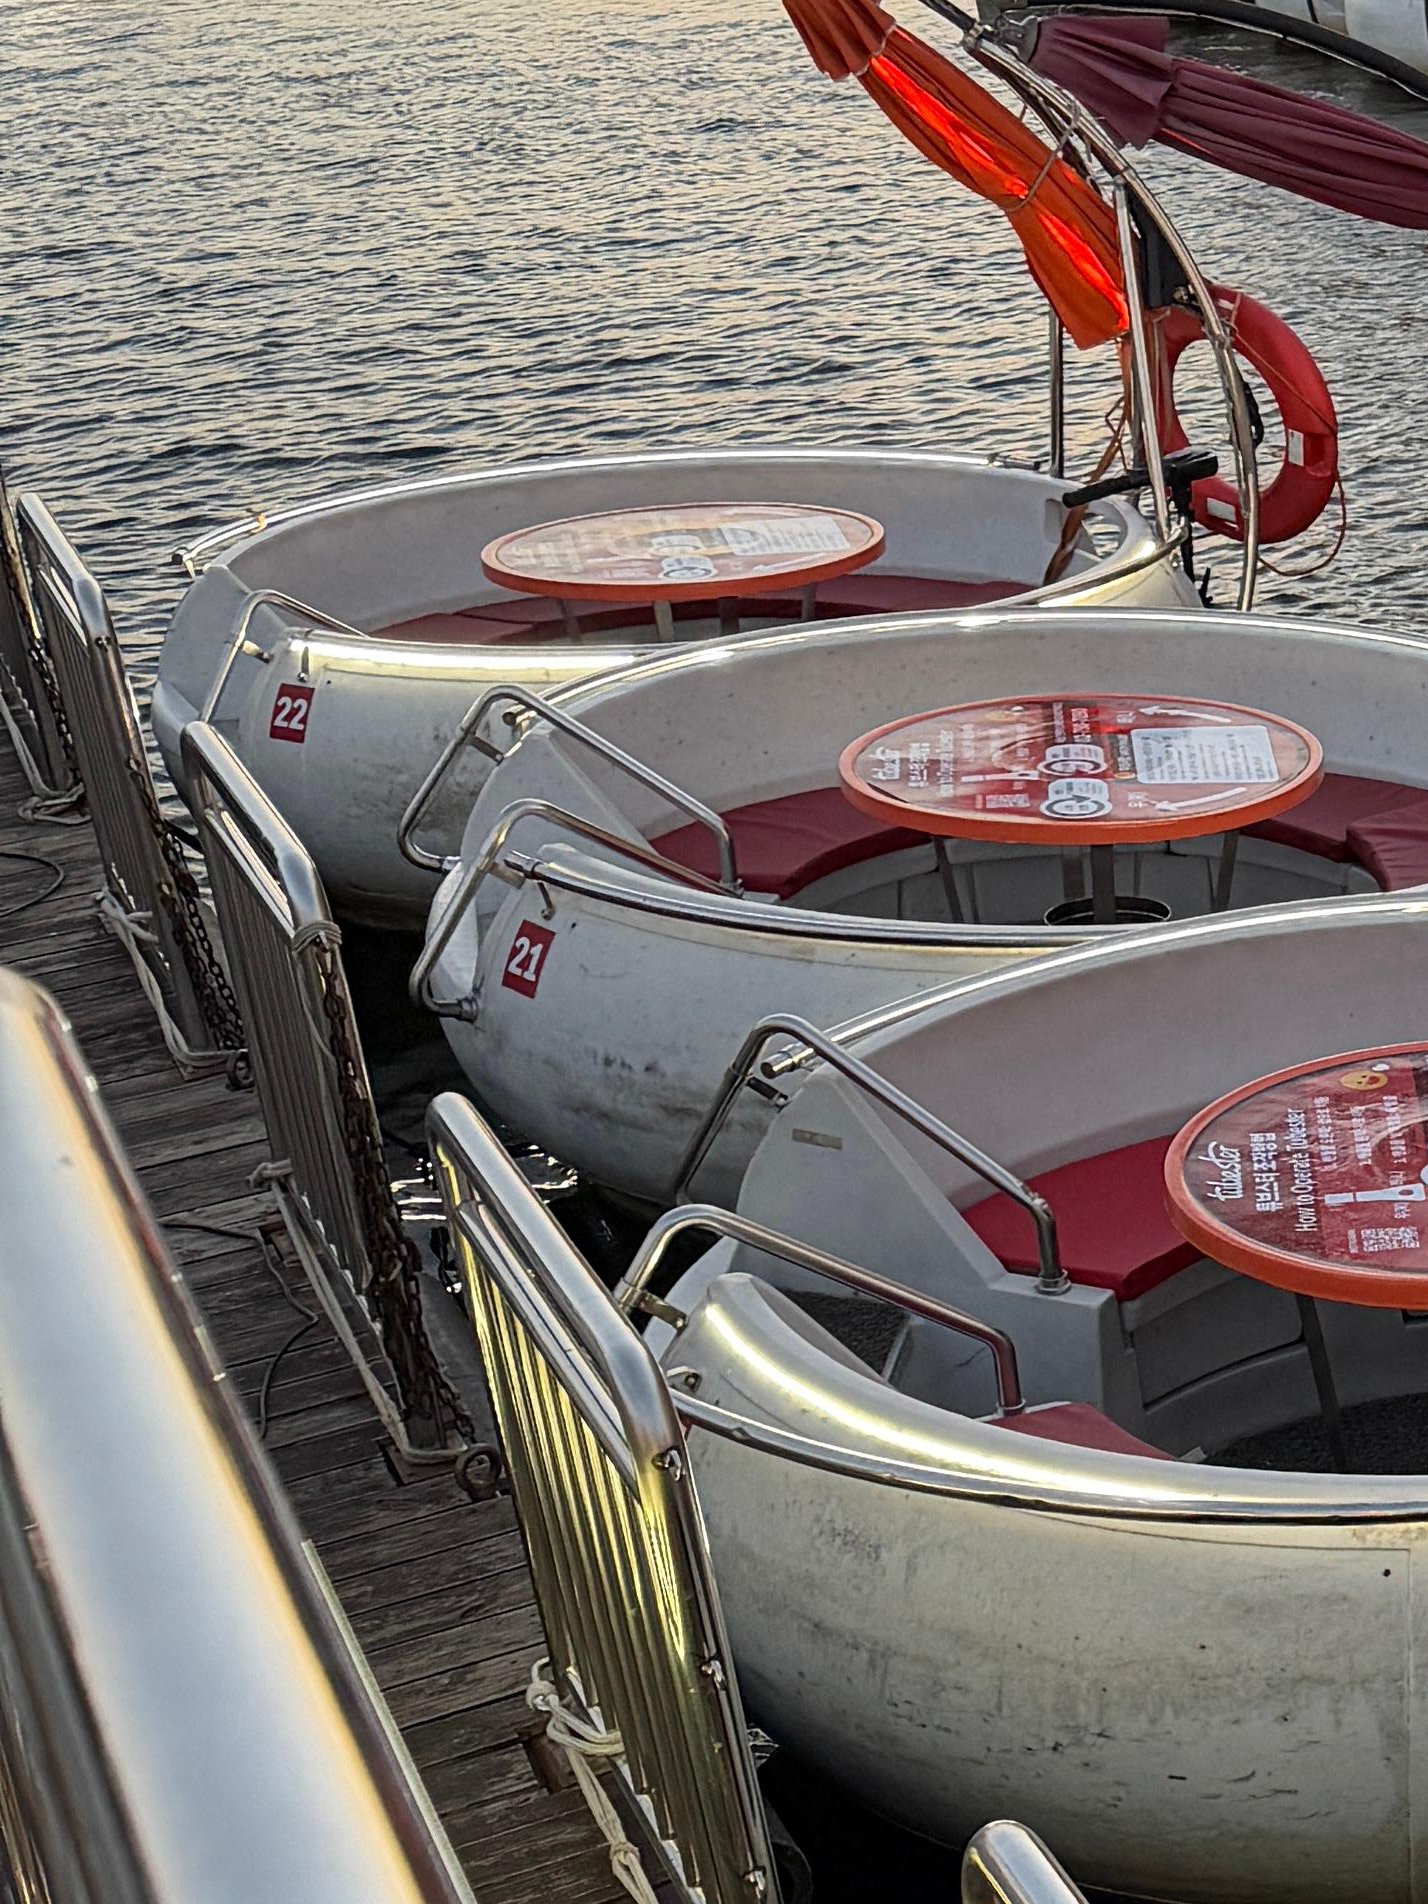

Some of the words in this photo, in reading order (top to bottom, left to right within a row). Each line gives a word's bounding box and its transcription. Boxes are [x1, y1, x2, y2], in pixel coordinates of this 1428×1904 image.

[273, 695, 310, 732] 22
[508, 935, 544, 984] 21
[1283, 1108, 1309, 1152] Tubester
[1198, 1141, 1244, 1202] tubester
[1252, 1172, 1285, 1212] 튜브스터
[1289, 1152, 1314, 1195] Operate
[1294, 1207, 1319, 1232] How
[1296, 1194, 1317, 1207] to
